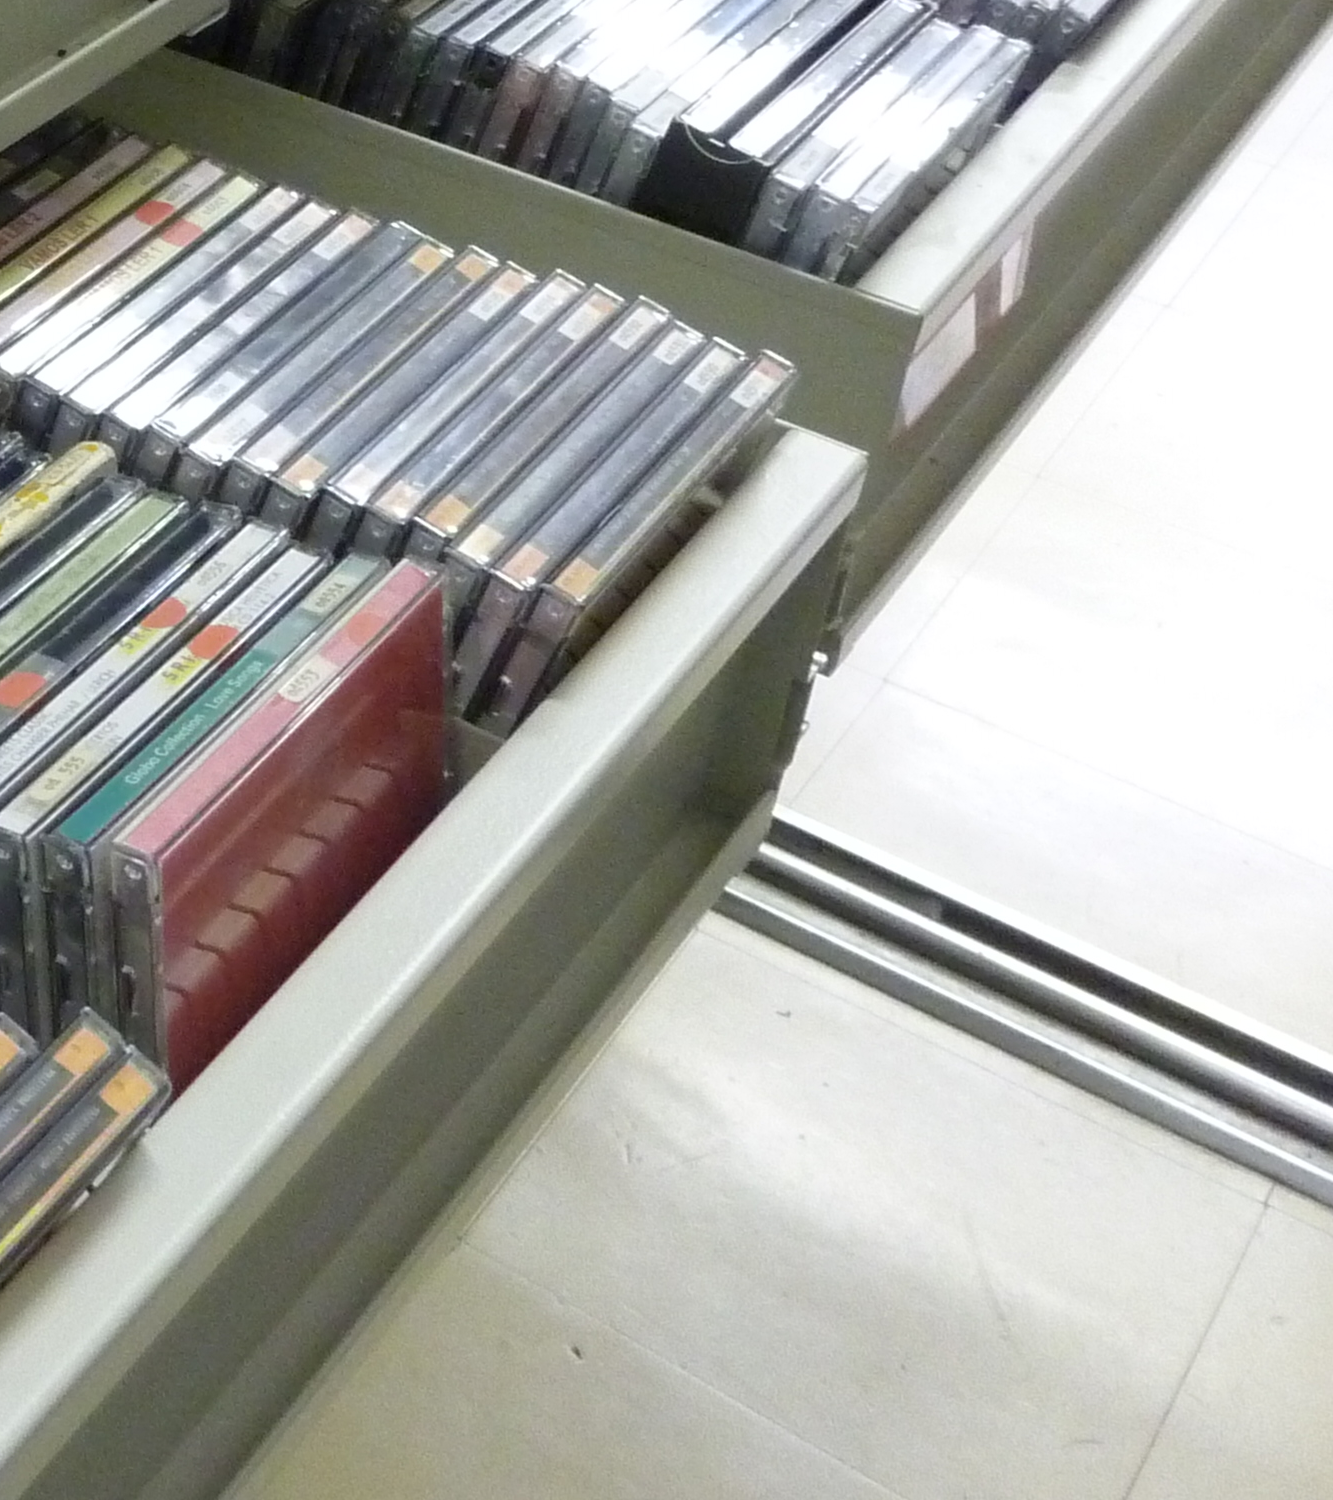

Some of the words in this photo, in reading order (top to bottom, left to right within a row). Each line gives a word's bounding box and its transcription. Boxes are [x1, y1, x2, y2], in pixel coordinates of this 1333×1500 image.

[66, 217, 92, 244] LER
[124, 754, 159, 786] Globo
[154, 711, 205, 757] Collection
[206, 682, 234, 711] Love
[231, 658, 266, 691] Songs
